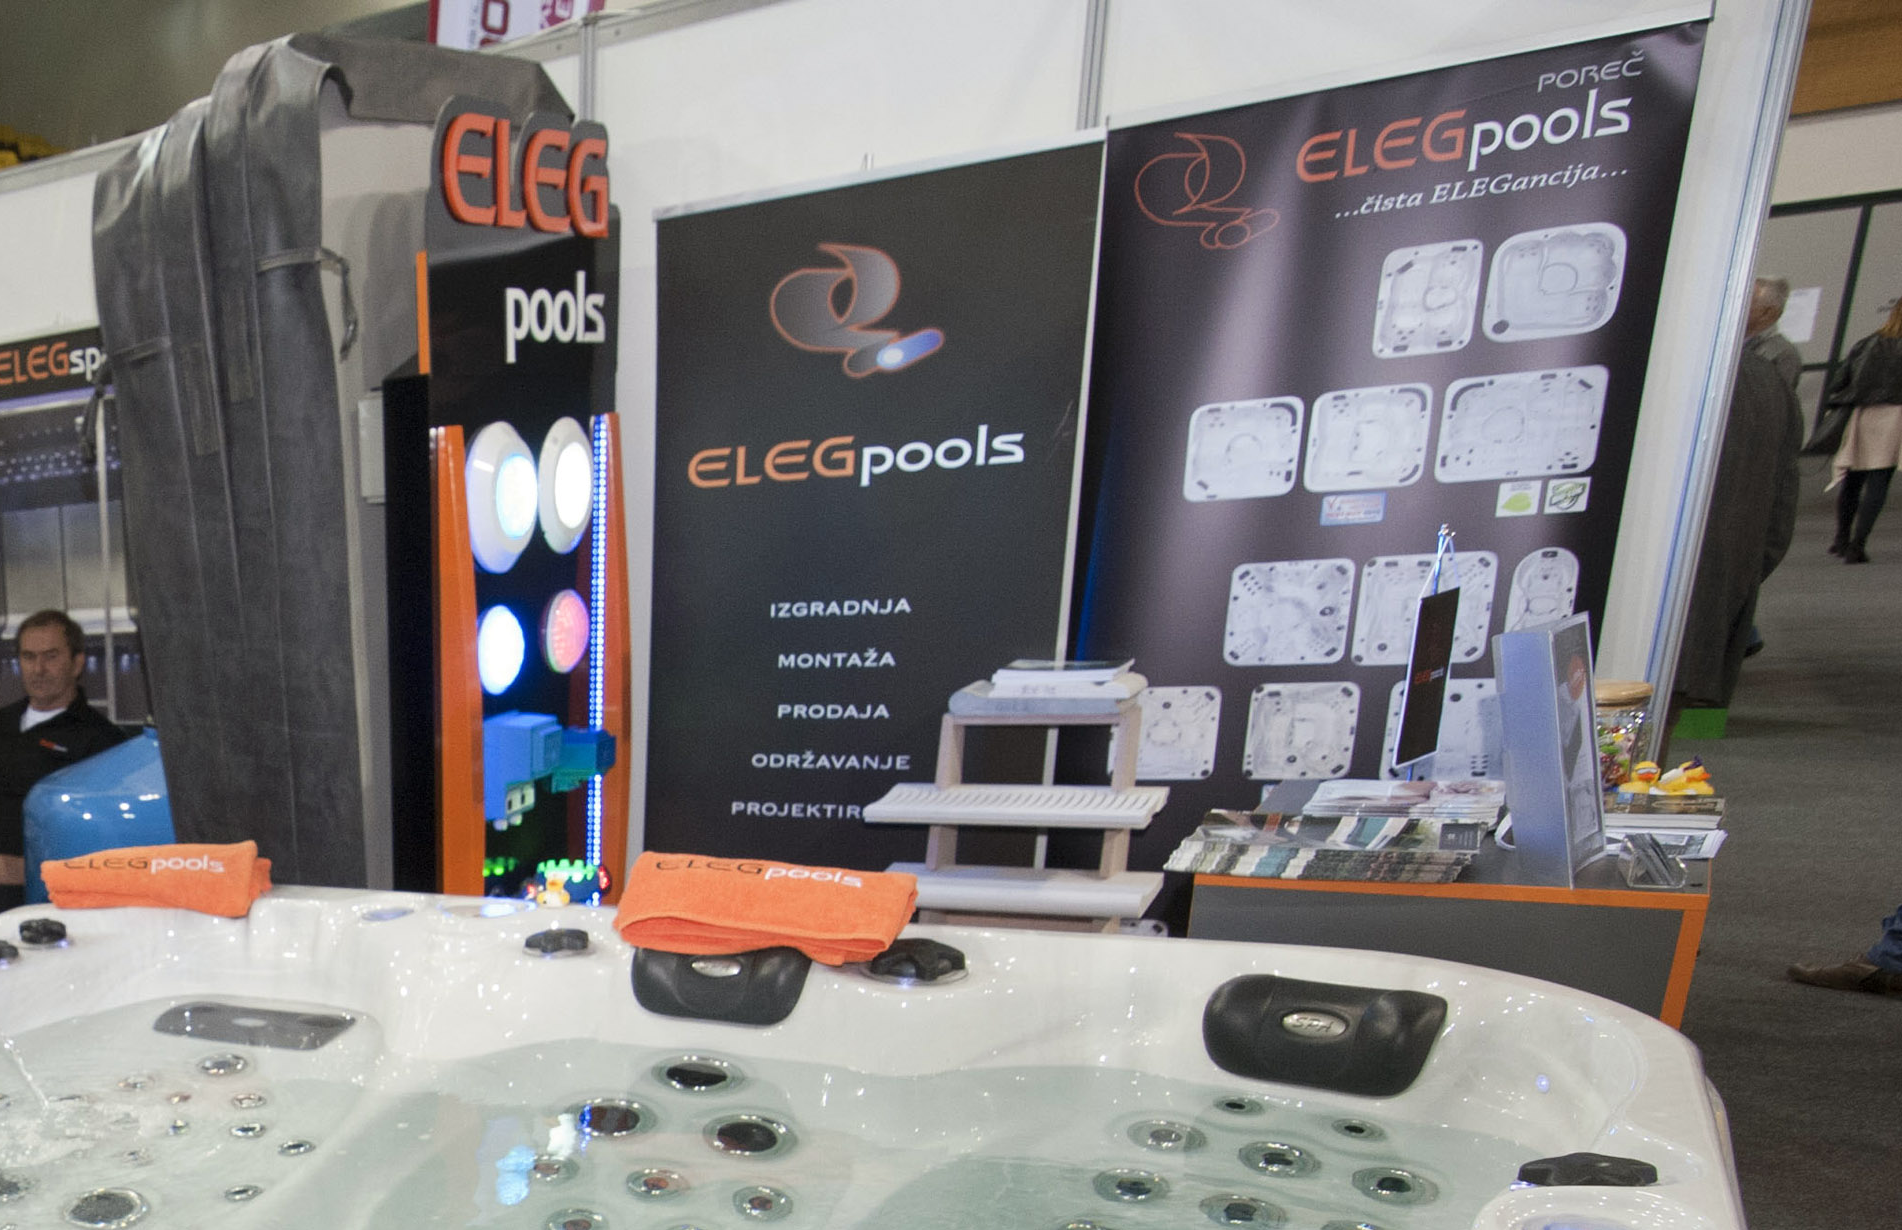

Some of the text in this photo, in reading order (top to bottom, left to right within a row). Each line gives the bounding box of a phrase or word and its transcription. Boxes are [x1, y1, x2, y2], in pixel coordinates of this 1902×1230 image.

[1538, 50, 1646, 93] POREČ
[1296, 88, 1633, 184] ELEGpools
[442, 112, 609, 239] ELEG
[505, 269, 606, 364] pools
[687, 424, 1025, 489] ELEGpools
[769, 597, 913, 619] IZGRADNJA
[777, 648, 896, 670] MONTAŽA
[777, 703, 890, 720] PRODAJA
[751, 749, 911, 771] ODRŽAVANJE
[731, 801, 866, 821] PROJEKTIR
